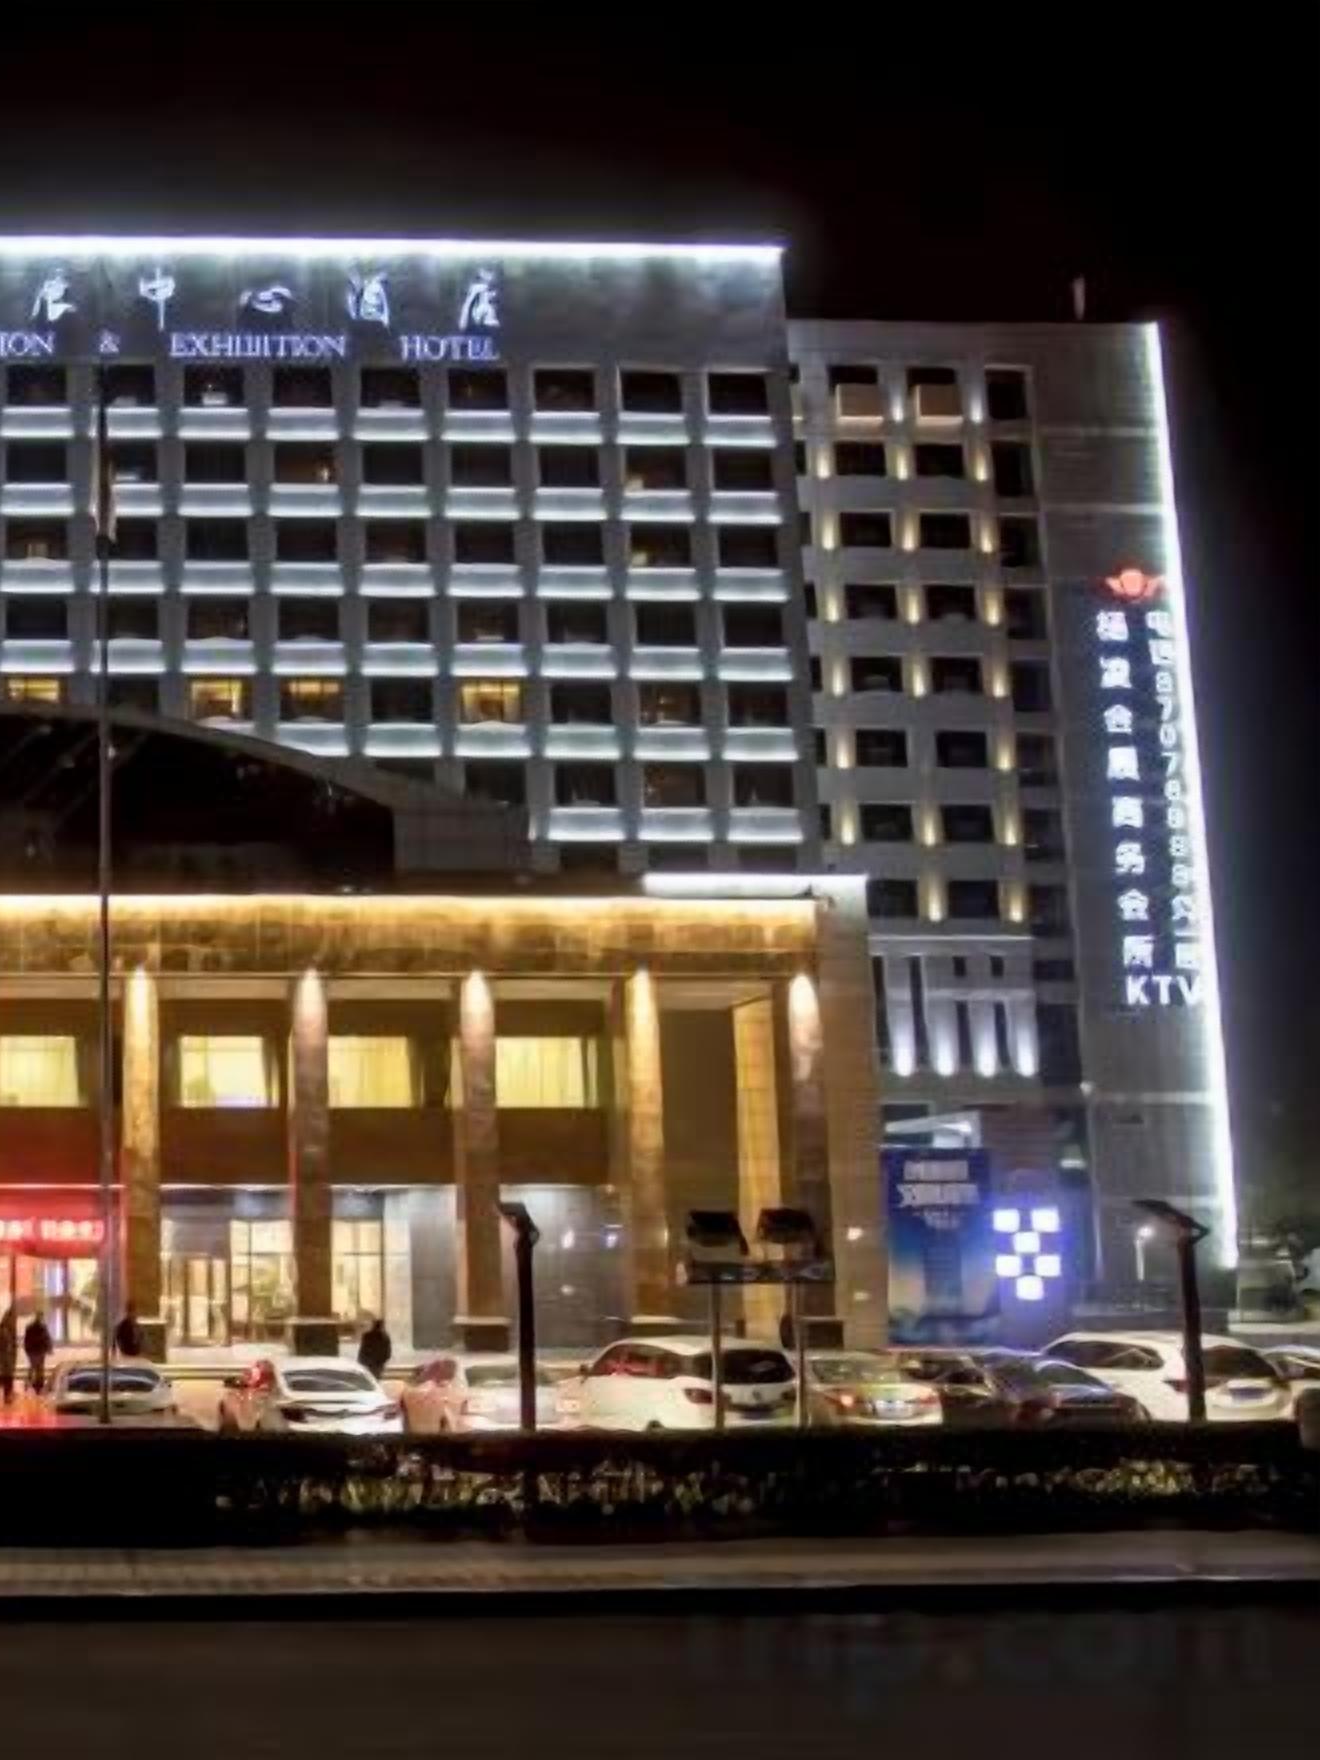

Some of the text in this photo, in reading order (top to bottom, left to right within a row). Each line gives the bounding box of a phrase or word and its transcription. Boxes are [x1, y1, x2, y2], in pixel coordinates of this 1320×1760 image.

[98, 331, 120, 355] &
[170, 332, 347, 358] EXHIBITION
[400, 335, 501, 361] HOTEL
[1126, 975, 1200, 1006] KTV
